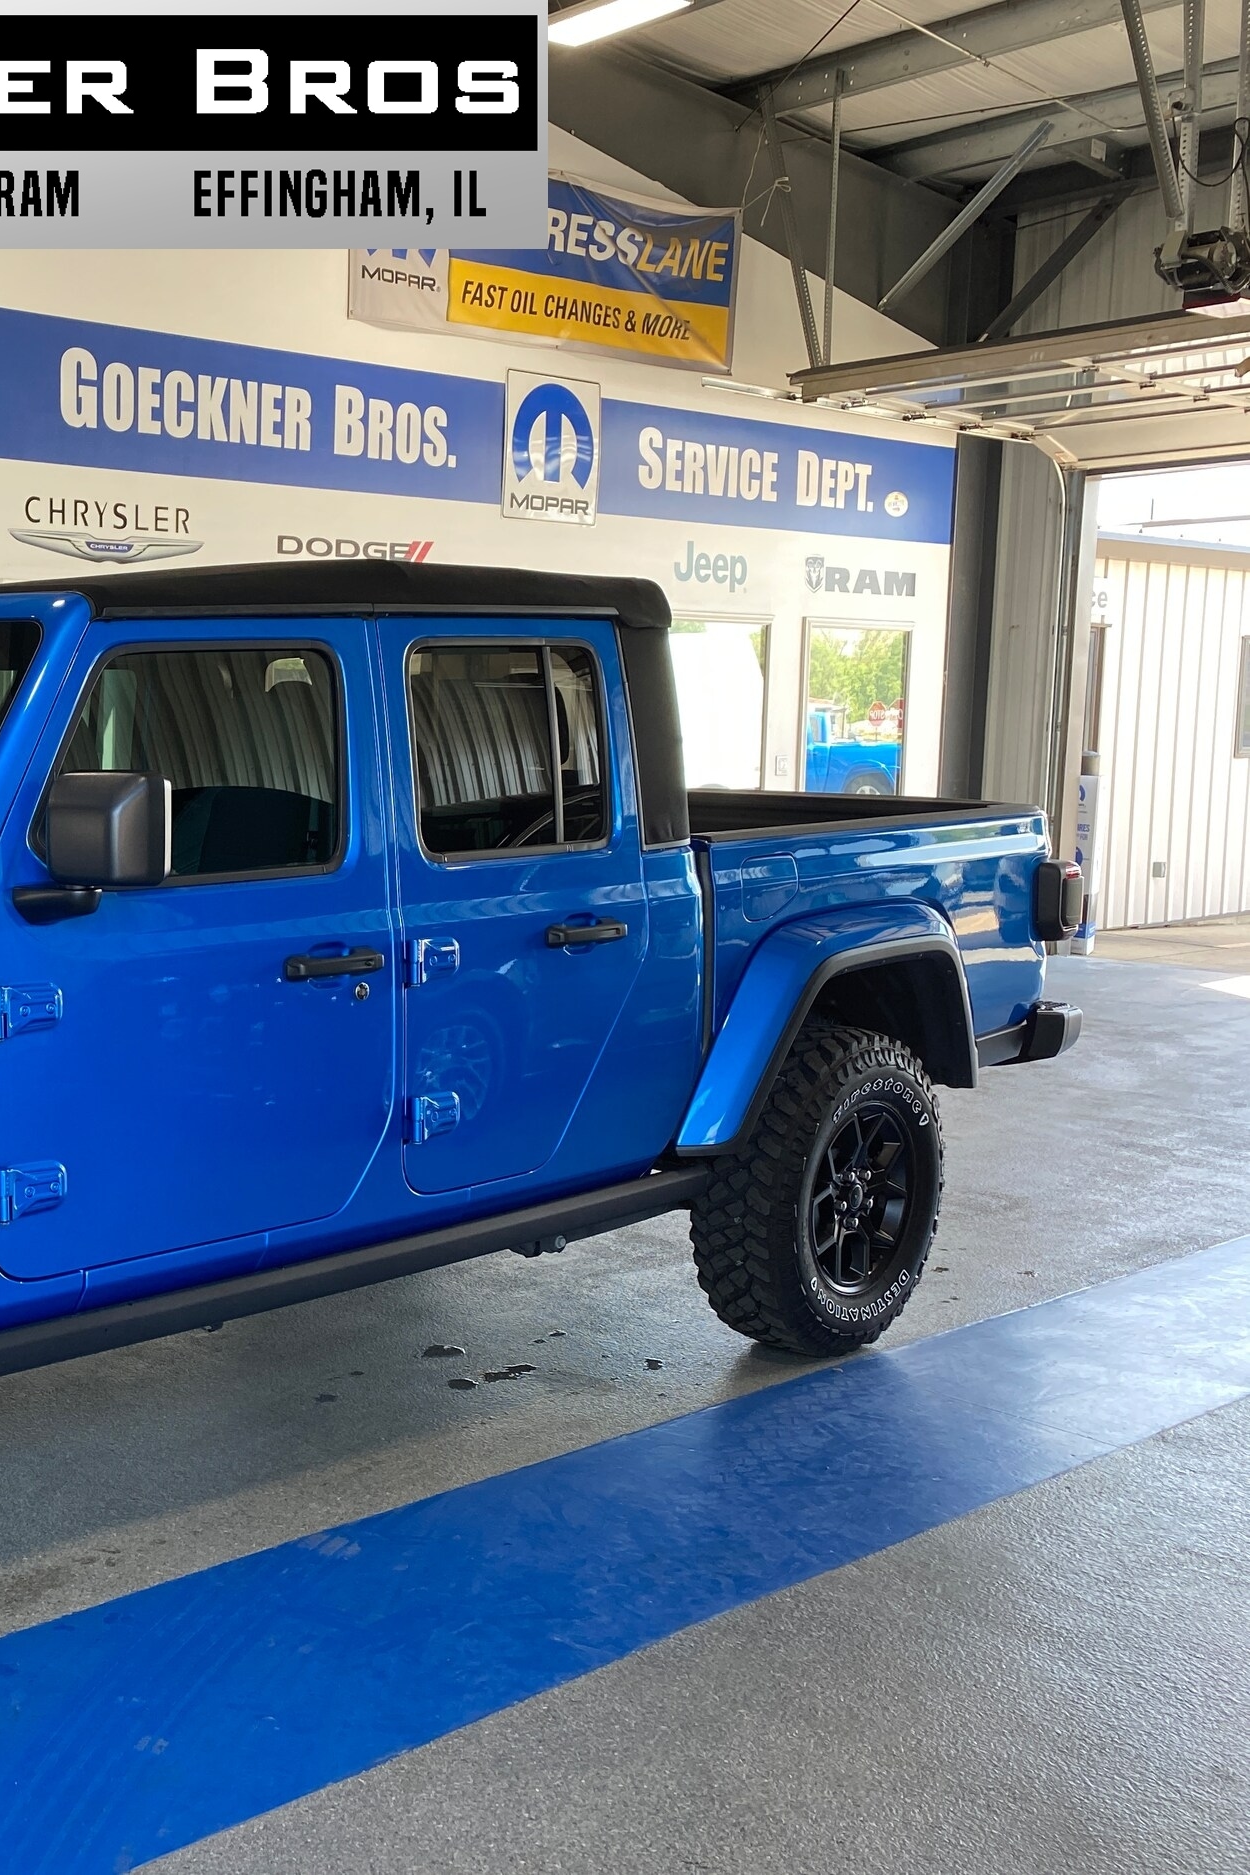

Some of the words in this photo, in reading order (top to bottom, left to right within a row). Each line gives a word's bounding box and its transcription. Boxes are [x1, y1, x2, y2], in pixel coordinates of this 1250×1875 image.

[361, 265, 437, 292] MOPAR
[461, 280, 508, 311] FAST
[510, 289, 538, 316] OIL
[543, 295, 621, 329] CHANGES
[625, 311, 637, 334] &
[640, 313, 691, 341] MORE
[60, 346, 312, 451] GOECKNER
[333, 384, 457, 469] BROS.
[638, 426, 779, 502] SERVICE
[796, 449, 874, 513] DEPT.
[24, 496, 190, 534] CHRYSLER
[509, 492, 591, 516] MOPAR
[89, 543, 128, 551] CHRYSLER
[276, 535, 413, 561] DODGE
[673, 540, 748, 593] Jeep
[824, 566, 917, 597] RAM
[816, 1268, 911, 1322] DESTINATION
